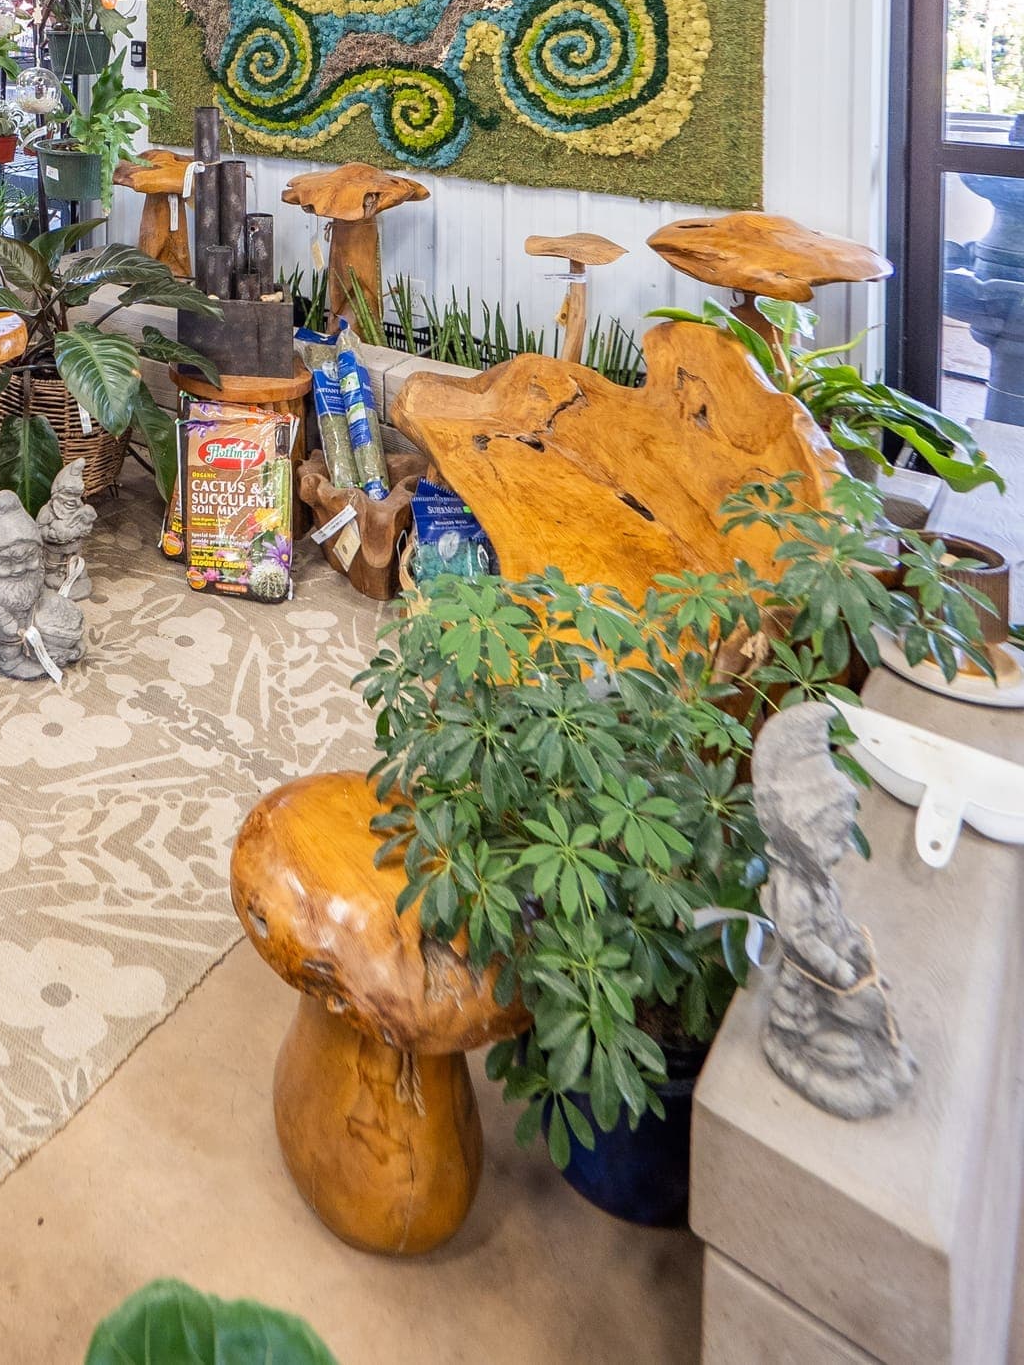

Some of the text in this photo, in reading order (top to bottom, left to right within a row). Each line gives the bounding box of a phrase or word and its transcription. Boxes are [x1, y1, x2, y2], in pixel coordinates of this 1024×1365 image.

[205, 442, 257, 463] Hoffman
[192, 471, 217, 479] ORGANIC
[191, 479, 261, 494] CACTUS &
[191, 492, 276, 508] SUCCULENT
[191, 504, 239, 515] SOIL MIX
